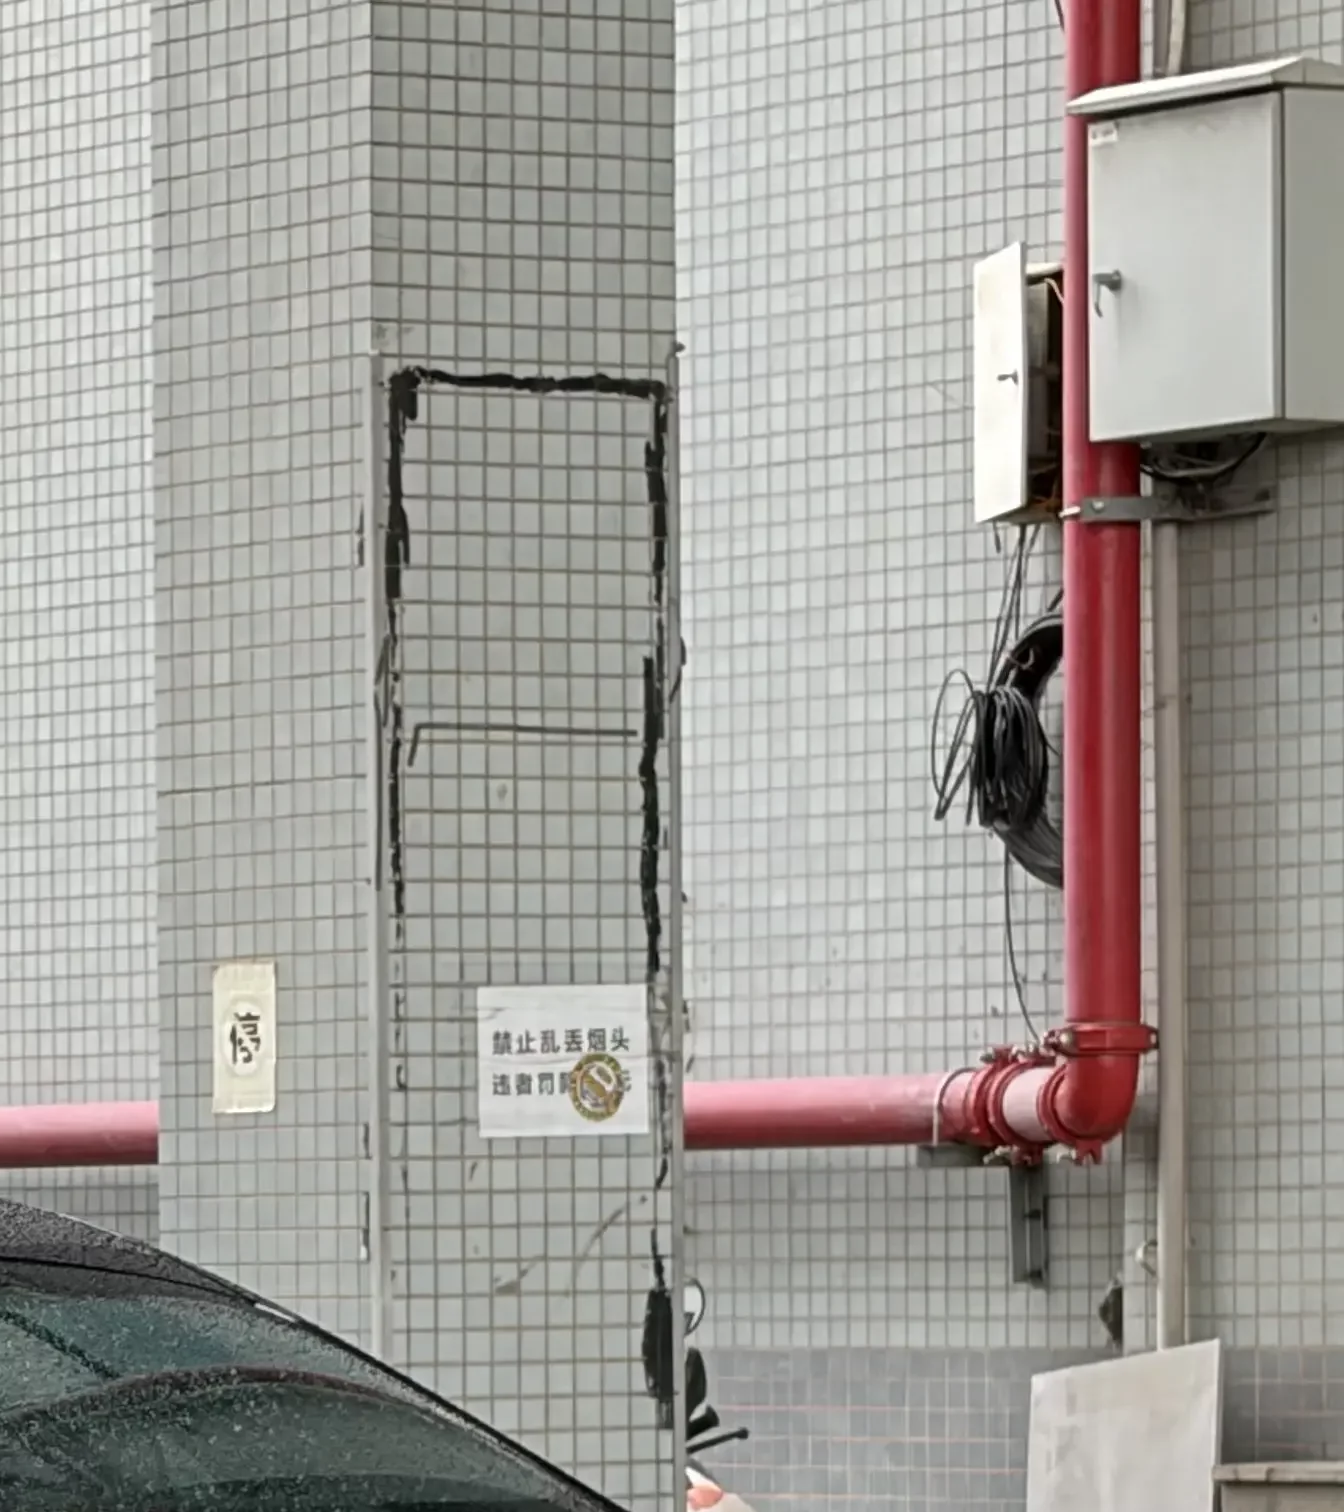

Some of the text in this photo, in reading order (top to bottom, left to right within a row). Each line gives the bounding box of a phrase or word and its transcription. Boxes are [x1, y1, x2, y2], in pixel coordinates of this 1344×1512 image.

[492, 1026, 630, 1055] 禁止乱丢烟头
